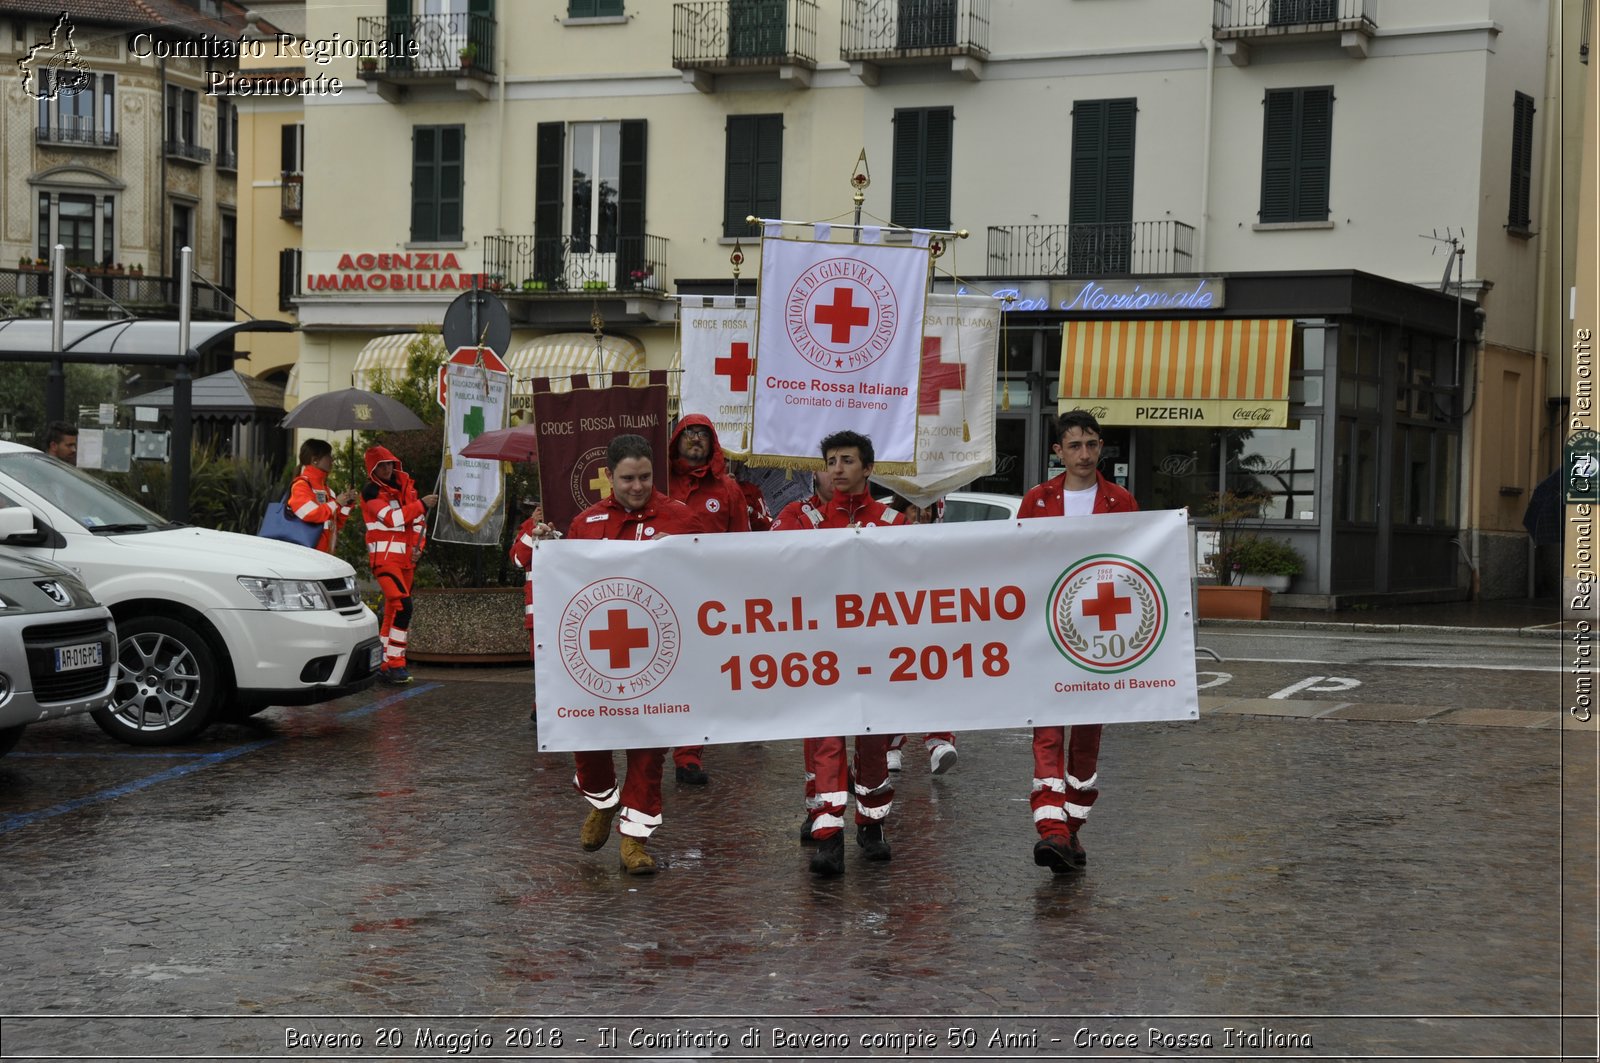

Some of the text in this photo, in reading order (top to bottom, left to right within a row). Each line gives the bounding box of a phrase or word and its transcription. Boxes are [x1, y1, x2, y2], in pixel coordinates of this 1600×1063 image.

[337, 253, 462, 271] AGENZIA
[307, 274, 489, 291] IMMOBILIARE
[992, 280, 1214, 312] Bar Nazionale
[789, 262, 894, 368] CONVENZIONE DI GINEVRA 22 AGOSTO 1864
[946, 316, 992, 328] ITALIANA
[692, 320, 718, 330] CROCE
[722, 320, 748, 330] ROSSA
[766, 376, 908, 396] Croce Rossa Italiana
[720, 405, 752, 414] COMITAT
[785, 394, 888, 410] Comitato di Baveno
[1136, 408, 1204, 420] PIZZERIA
[541, 413, 660, 435] CROCE ROSSA ITALIANA
[585, 450, 606, 460] GINEV
[949, 452, 980, 462] TOCE
[697, 585, 1026, 636] C.R.I. BAVENO
[564, 583, 676, 694] CONVENZIONE DI GINEVRA 22 AGOSTO 1864
[1092, 634, 1126, 660] 50
[720, 651, 840, 691] 1968
[889, 642, 1009, 682] 2018
[1054, 678, 1176, 693] Comitato di Baveno
[557, 702, 690, 718] Croce Rossa Italiana
